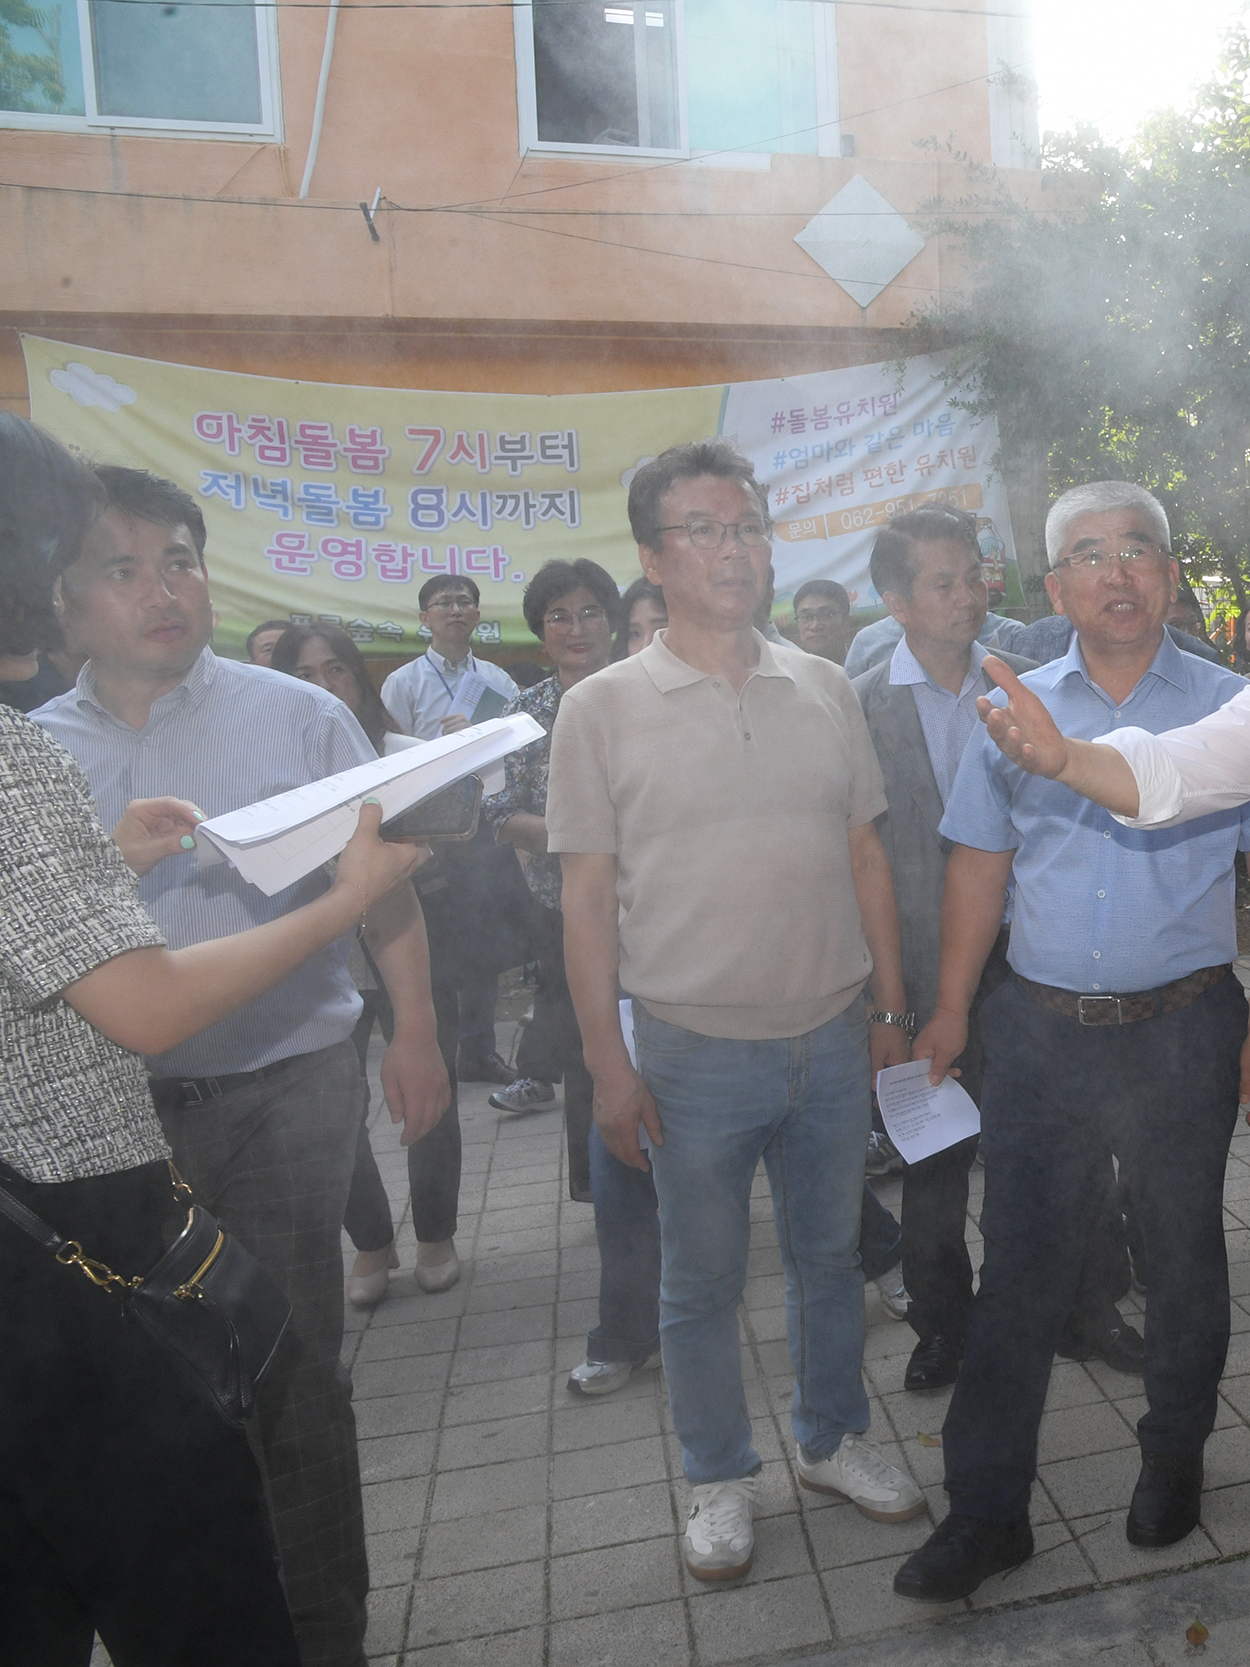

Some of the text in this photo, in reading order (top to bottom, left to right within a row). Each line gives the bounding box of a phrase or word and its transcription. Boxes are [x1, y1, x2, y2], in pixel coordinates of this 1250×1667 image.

[771, 393, 898, 435] #돌봄유치원
[772, 413, 956, 470] #엄마와 같은 마음
[196, 414, 576, 472] 아침돌봄 7시부터
[200, 471, 577, 528] 저녁돌봄 8시까지
[775, 445, 978, 506] #집처럼 편한 유치원
[267, 532, 521, 580] 운영합니다.
[787, 518, 818, 539] 문의
